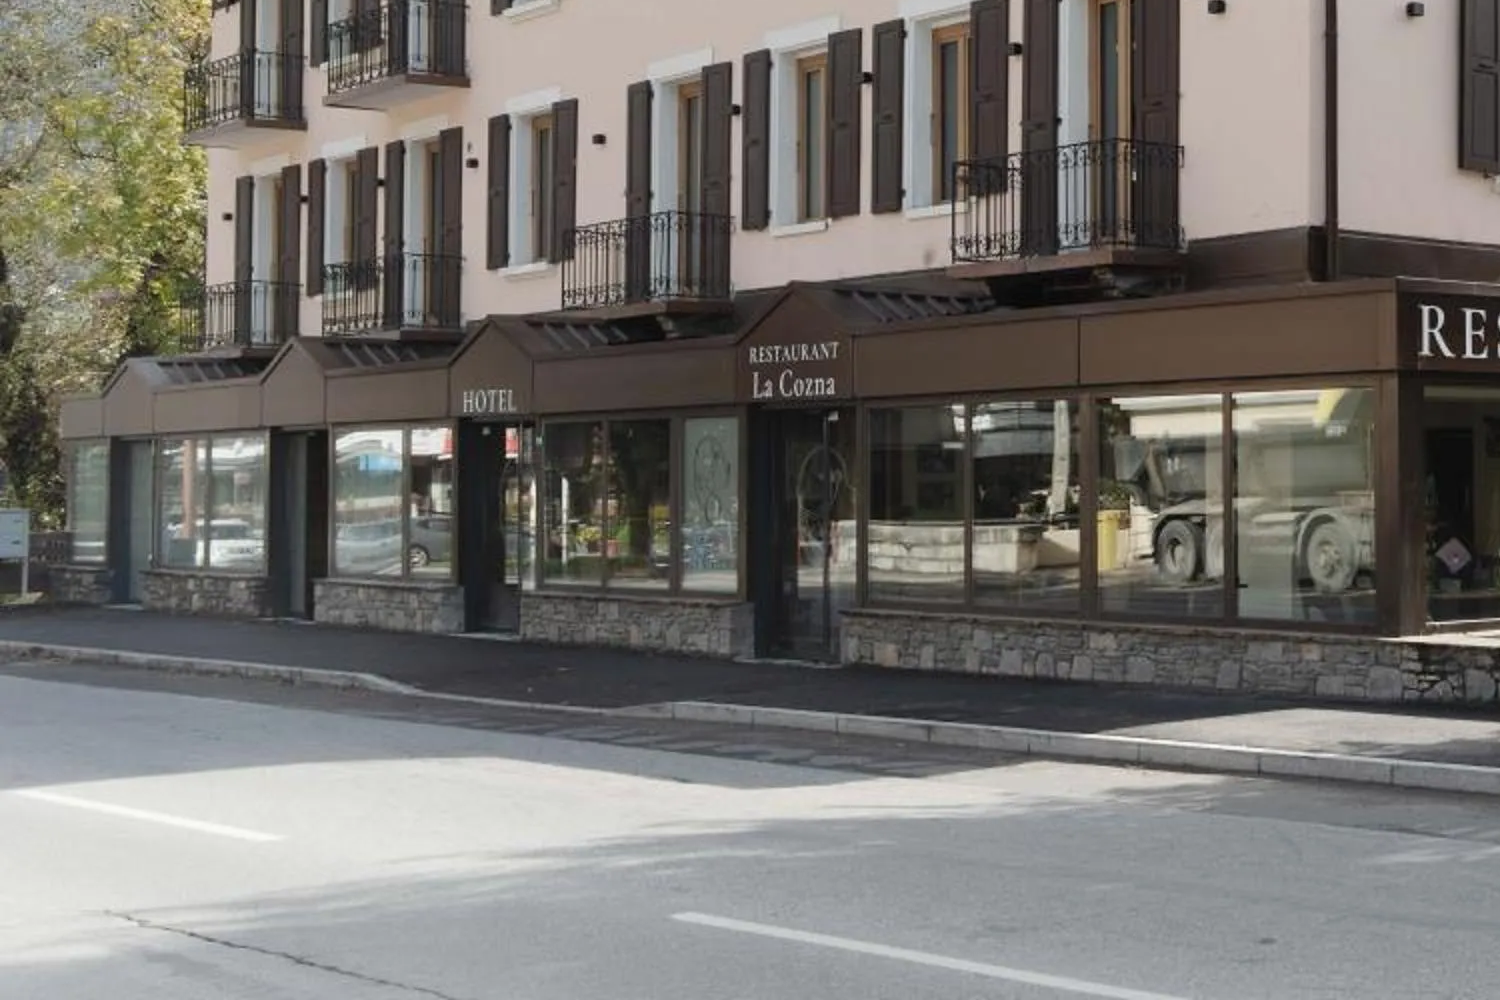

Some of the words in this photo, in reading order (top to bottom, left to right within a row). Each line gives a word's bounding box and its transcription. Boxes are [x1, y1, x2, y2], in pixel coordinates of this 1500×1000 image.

[749, 341, 840, 364] RESTAURANT
[752, 371, 773, 399] La
[779, 368, 836, 397] Cozna
[463, 389, 517, 413] HOTEL
